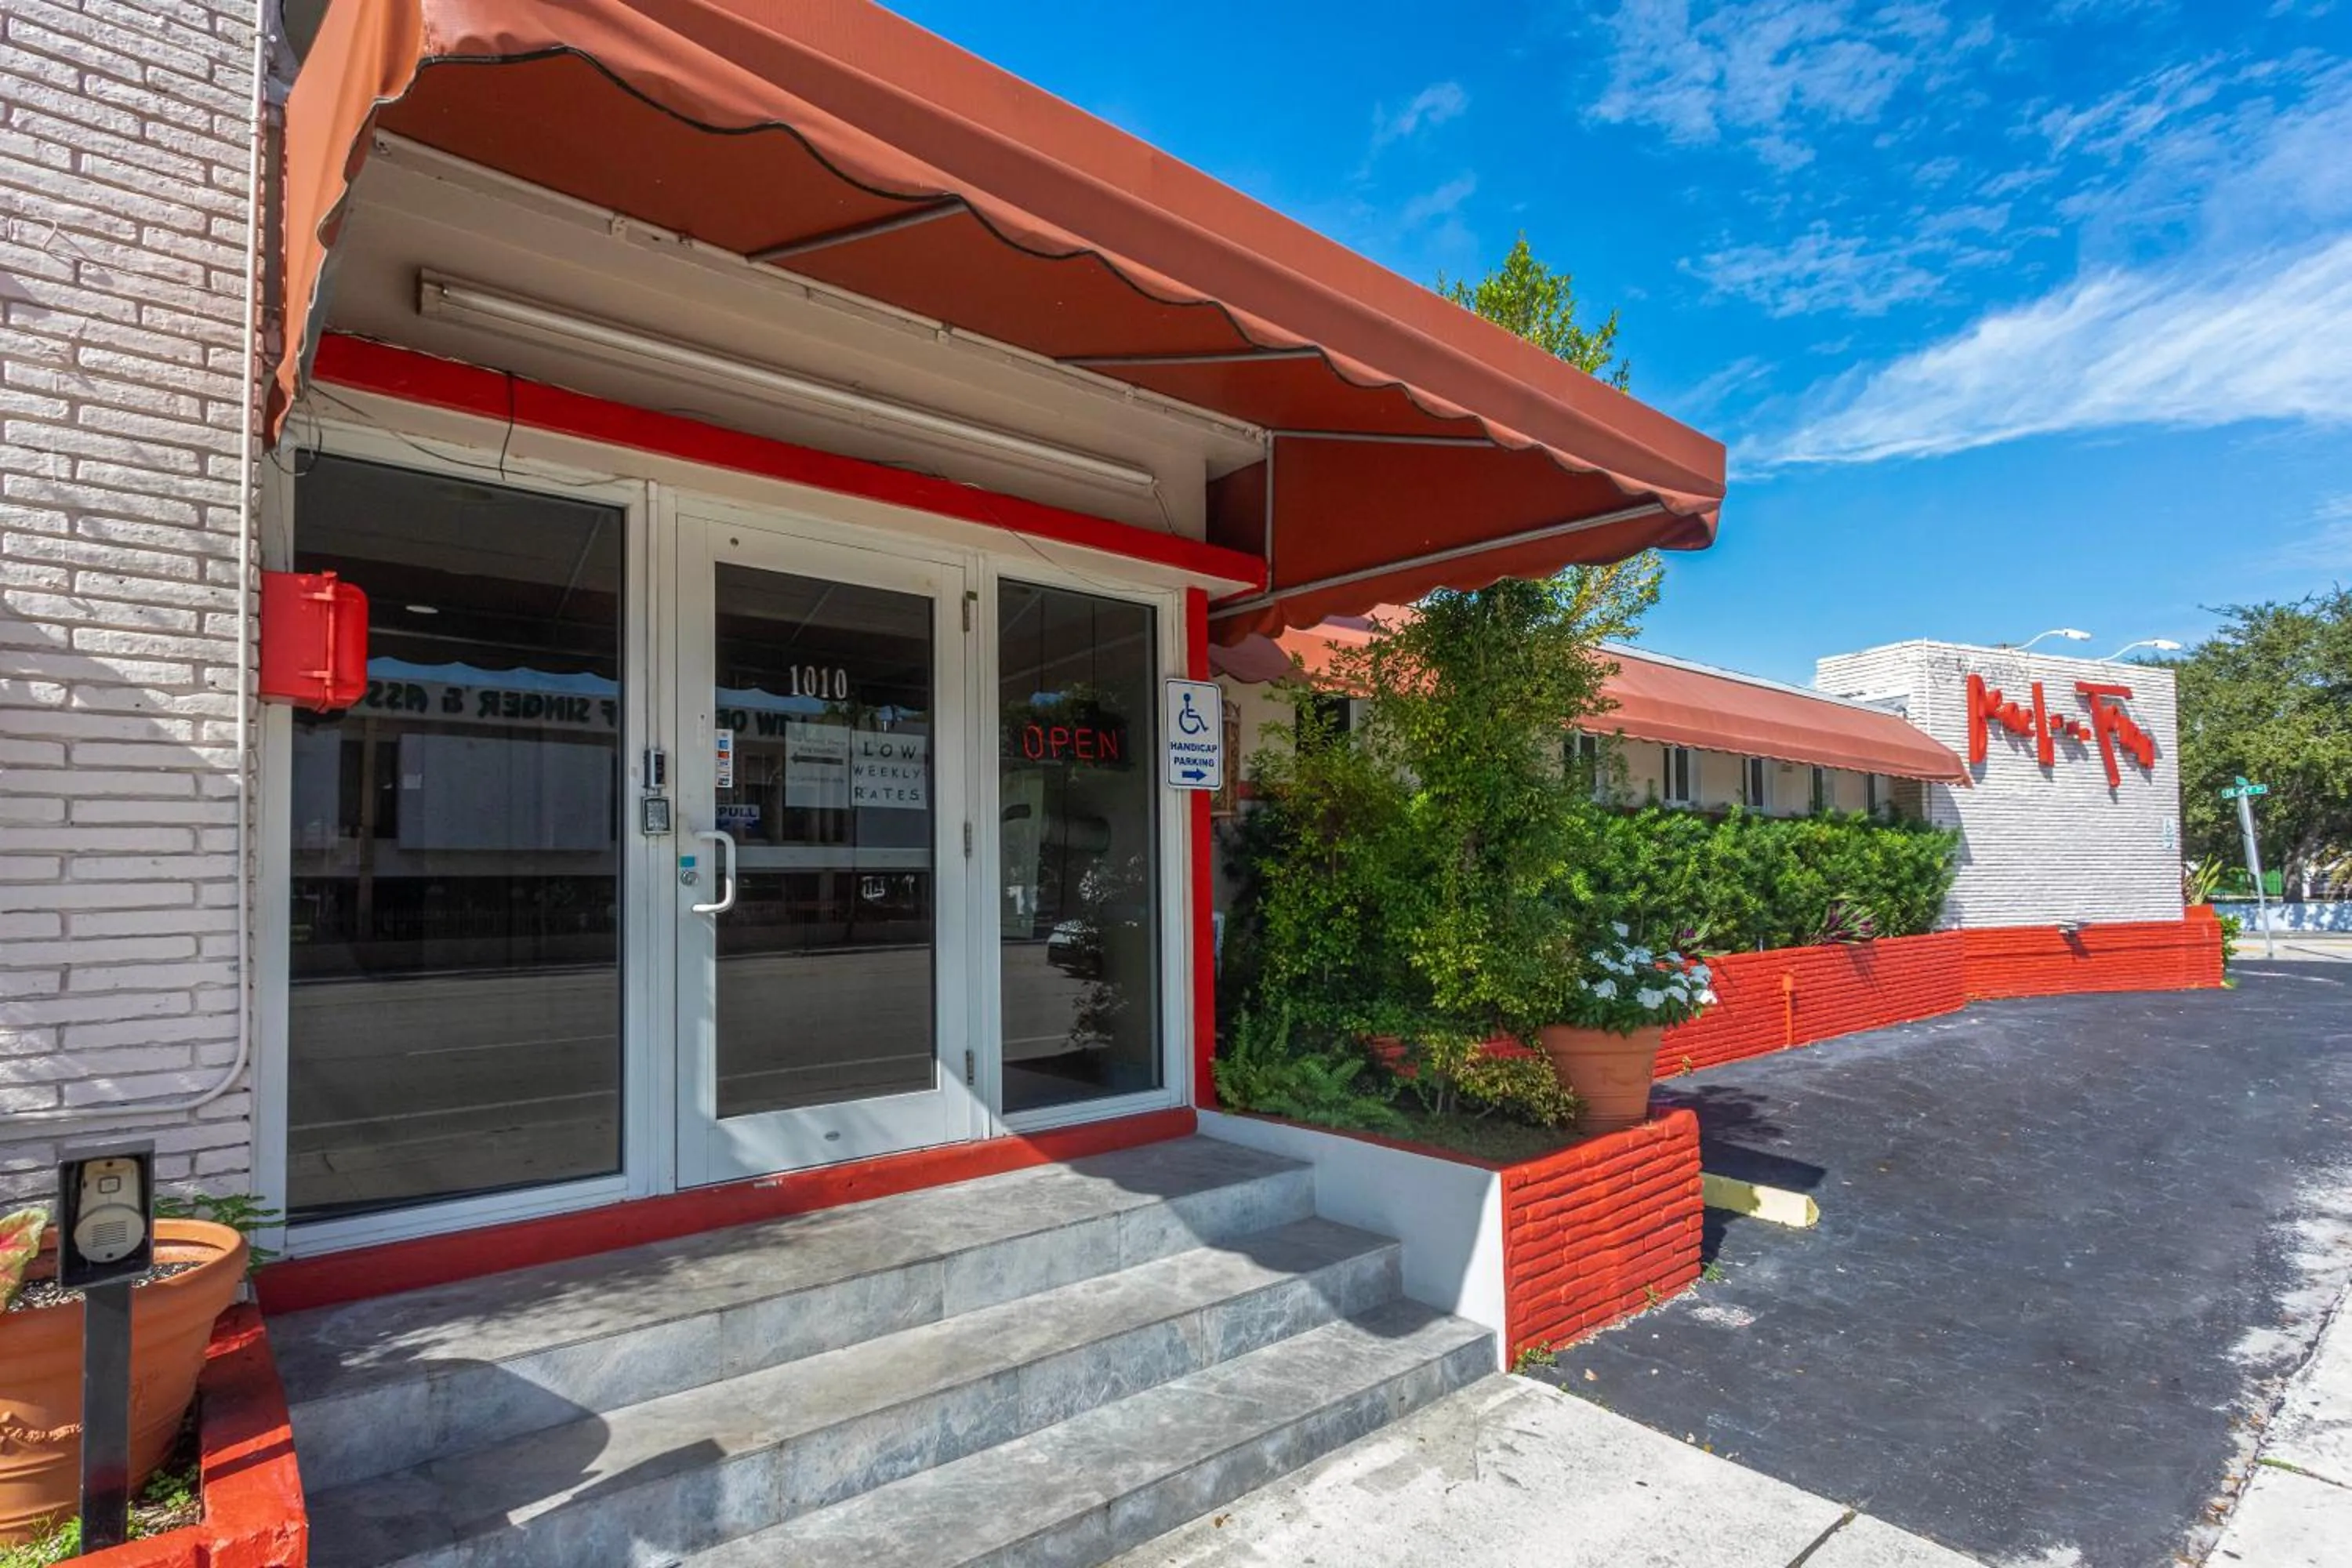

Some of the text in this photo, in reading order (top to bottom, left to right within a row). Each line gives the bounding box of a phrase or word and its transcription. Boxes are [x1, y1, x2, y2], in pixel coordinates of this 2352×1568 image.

[789, 664, 848, 699] 1010
[1022, 724, 1119, 760] OPEN
[1170, 741, 1218, 753] HANDICAP
[864, 742, 916, 760] LOW
[1174, 756, 1214, 768] PARKING
[852, 764, 920, 779] WEEKLY
[854, 786, 920, 800] RATES
[718, 807, 757, 818] PULL
